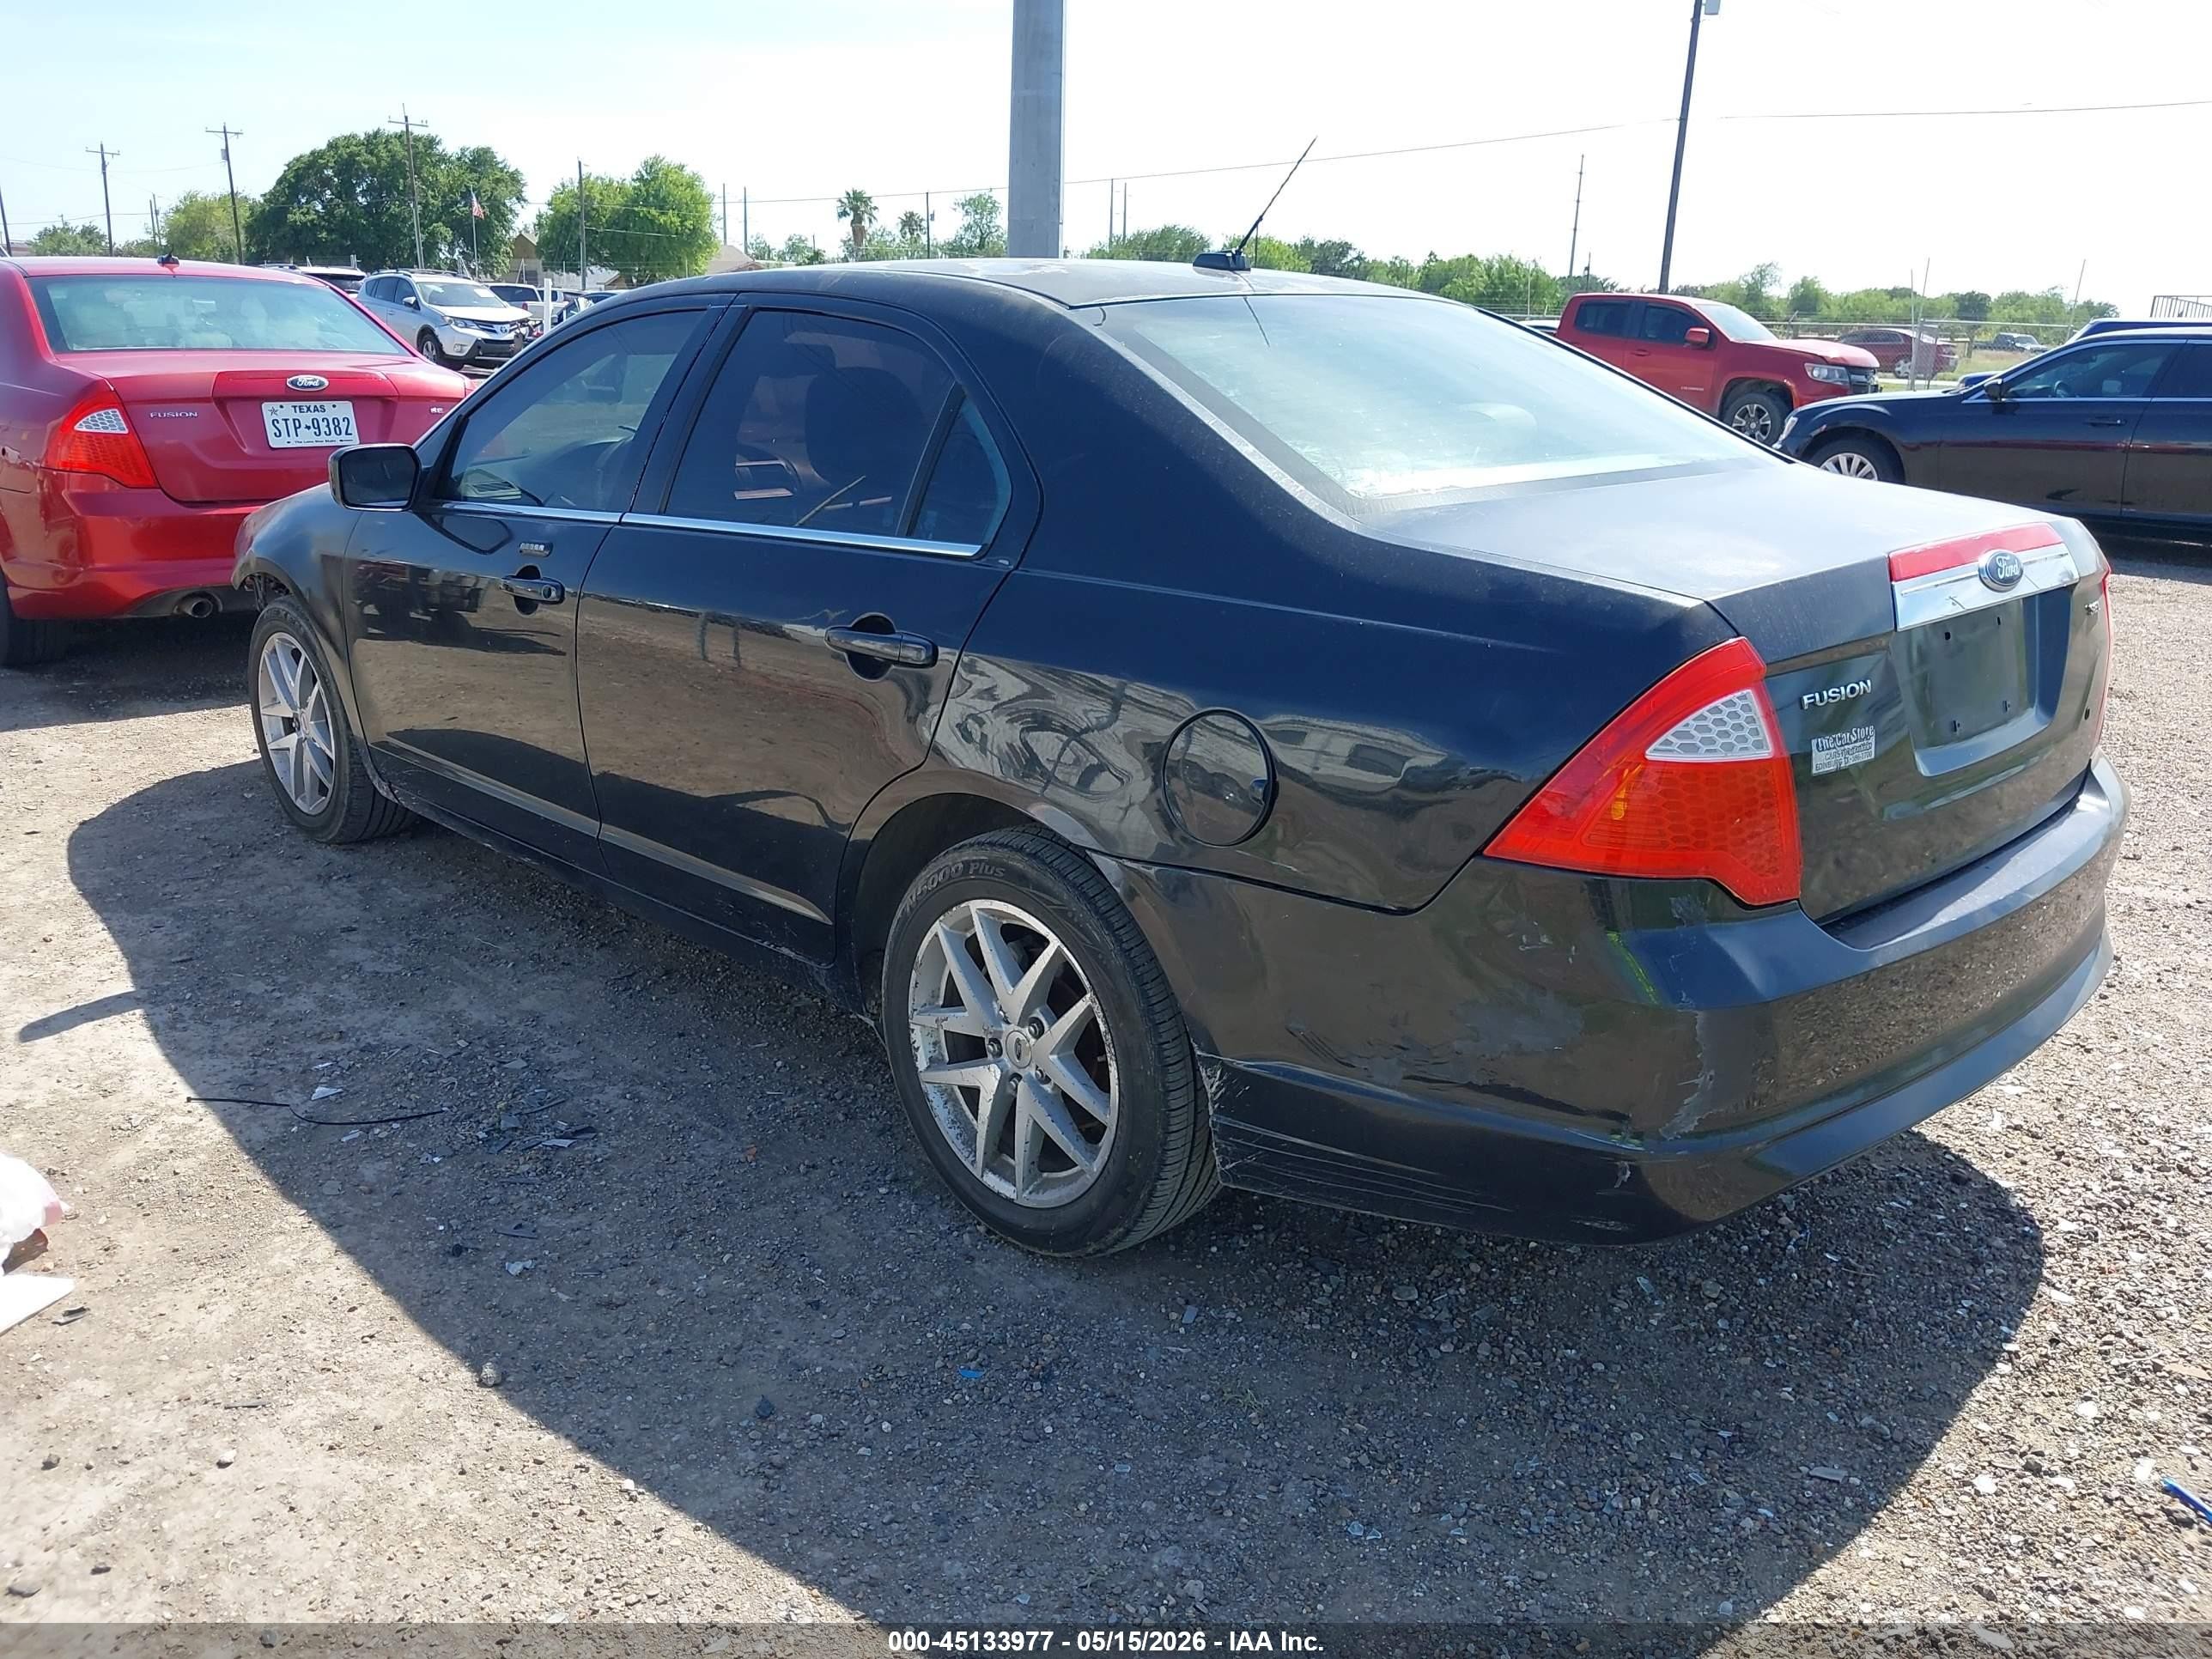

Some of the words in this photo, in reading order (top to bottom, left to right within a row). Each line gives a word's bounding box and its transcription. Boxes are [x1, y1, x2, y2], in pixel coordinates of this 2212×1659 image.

[297, 377, 319, 386] Ford
[291, 404, 326, 414] TEXAS
[1996, 556, 2019, 580] Ford
[1802, 679, 1872, 709] FUSION
[1835, 732, 1850, 746] Car
[1851, 725, 1875, 741] Store
[969, 862, 1006, 878] Plus
